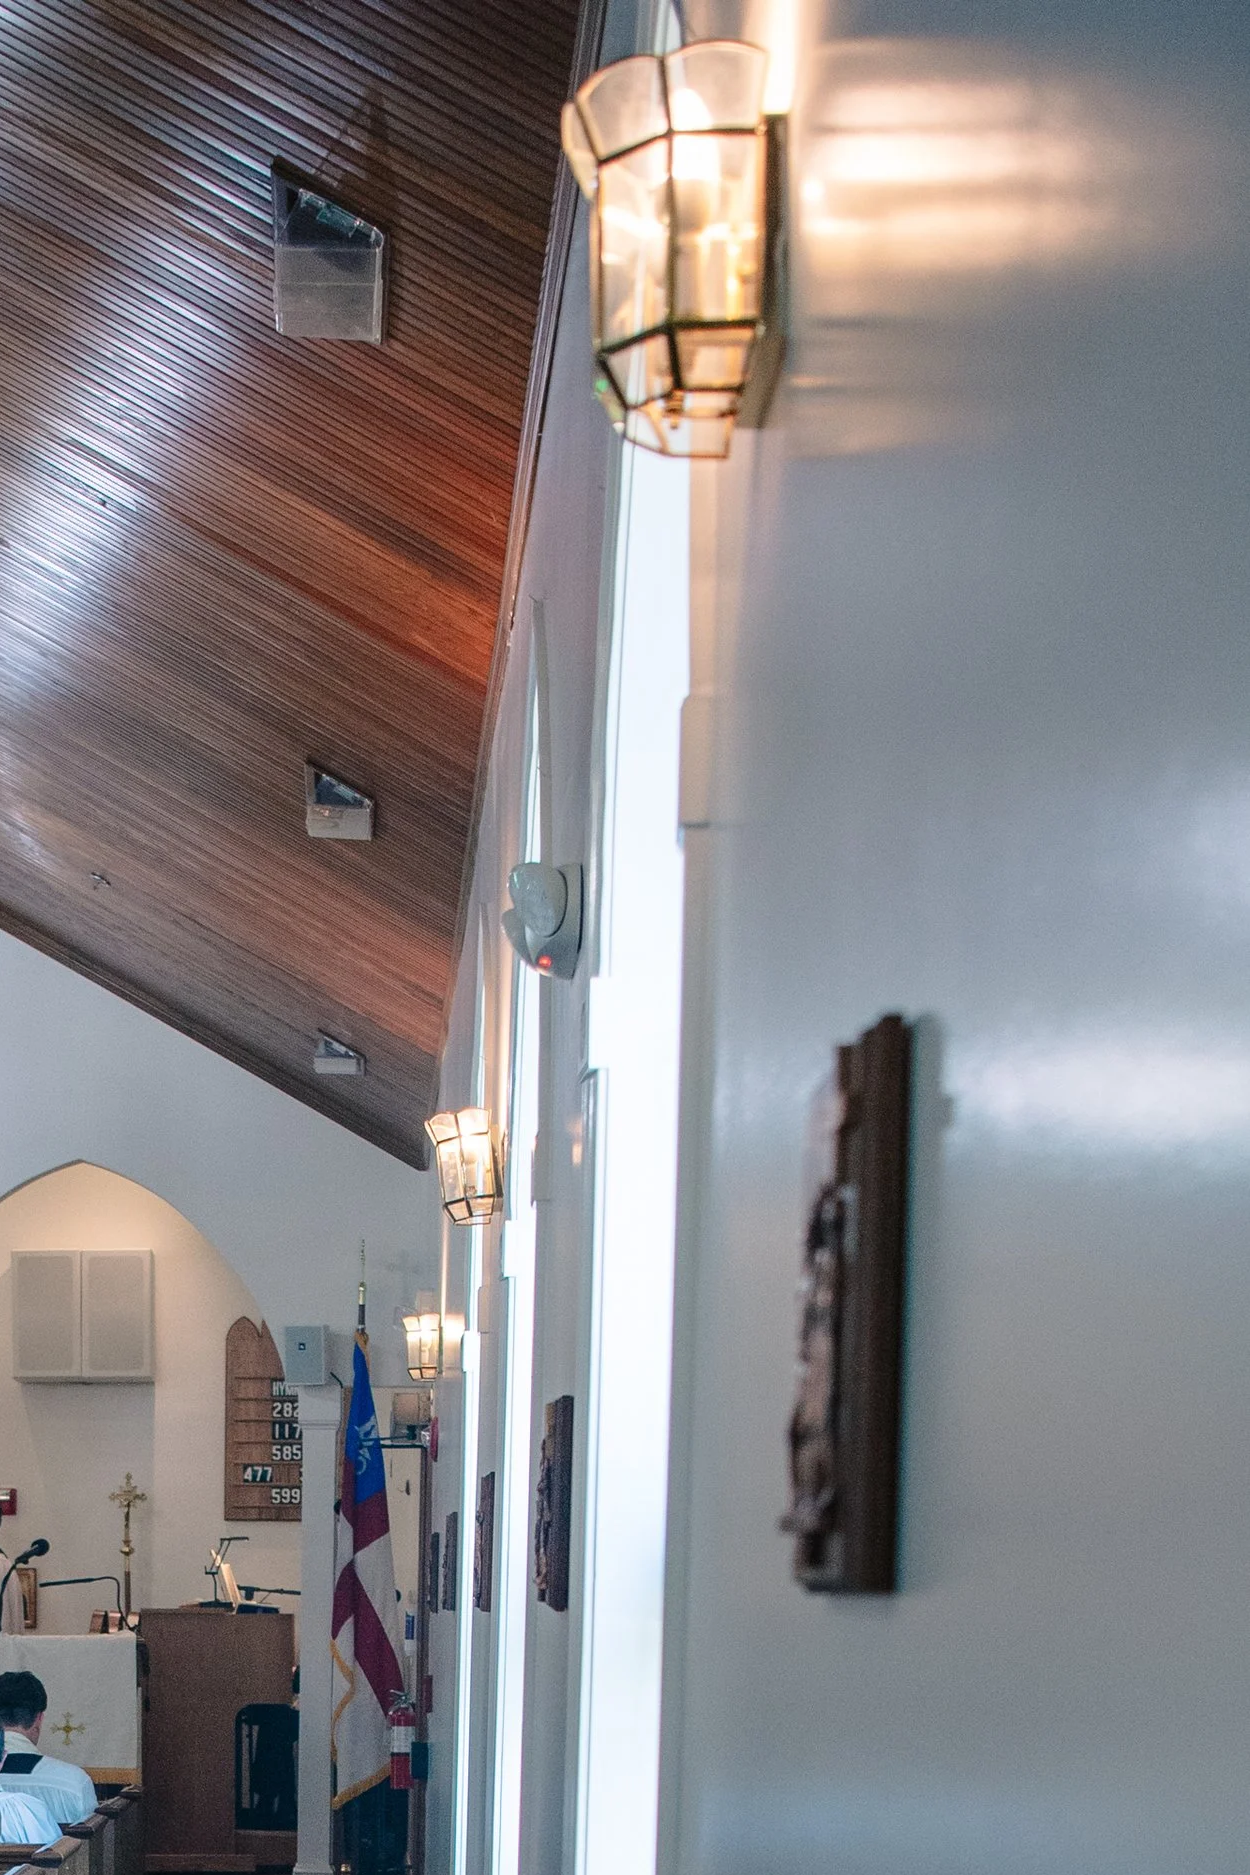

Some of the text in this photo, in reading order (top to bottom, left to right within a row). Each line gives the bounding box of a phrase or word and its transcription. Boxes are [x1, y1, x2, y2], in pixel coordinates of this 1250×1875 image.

[274, 1423, 301, 1439] 117
[272, 1444, 301, 1461] 585
[244, 1466, 272, 1482] 477
[271, 1487, 301, 1504] 599
